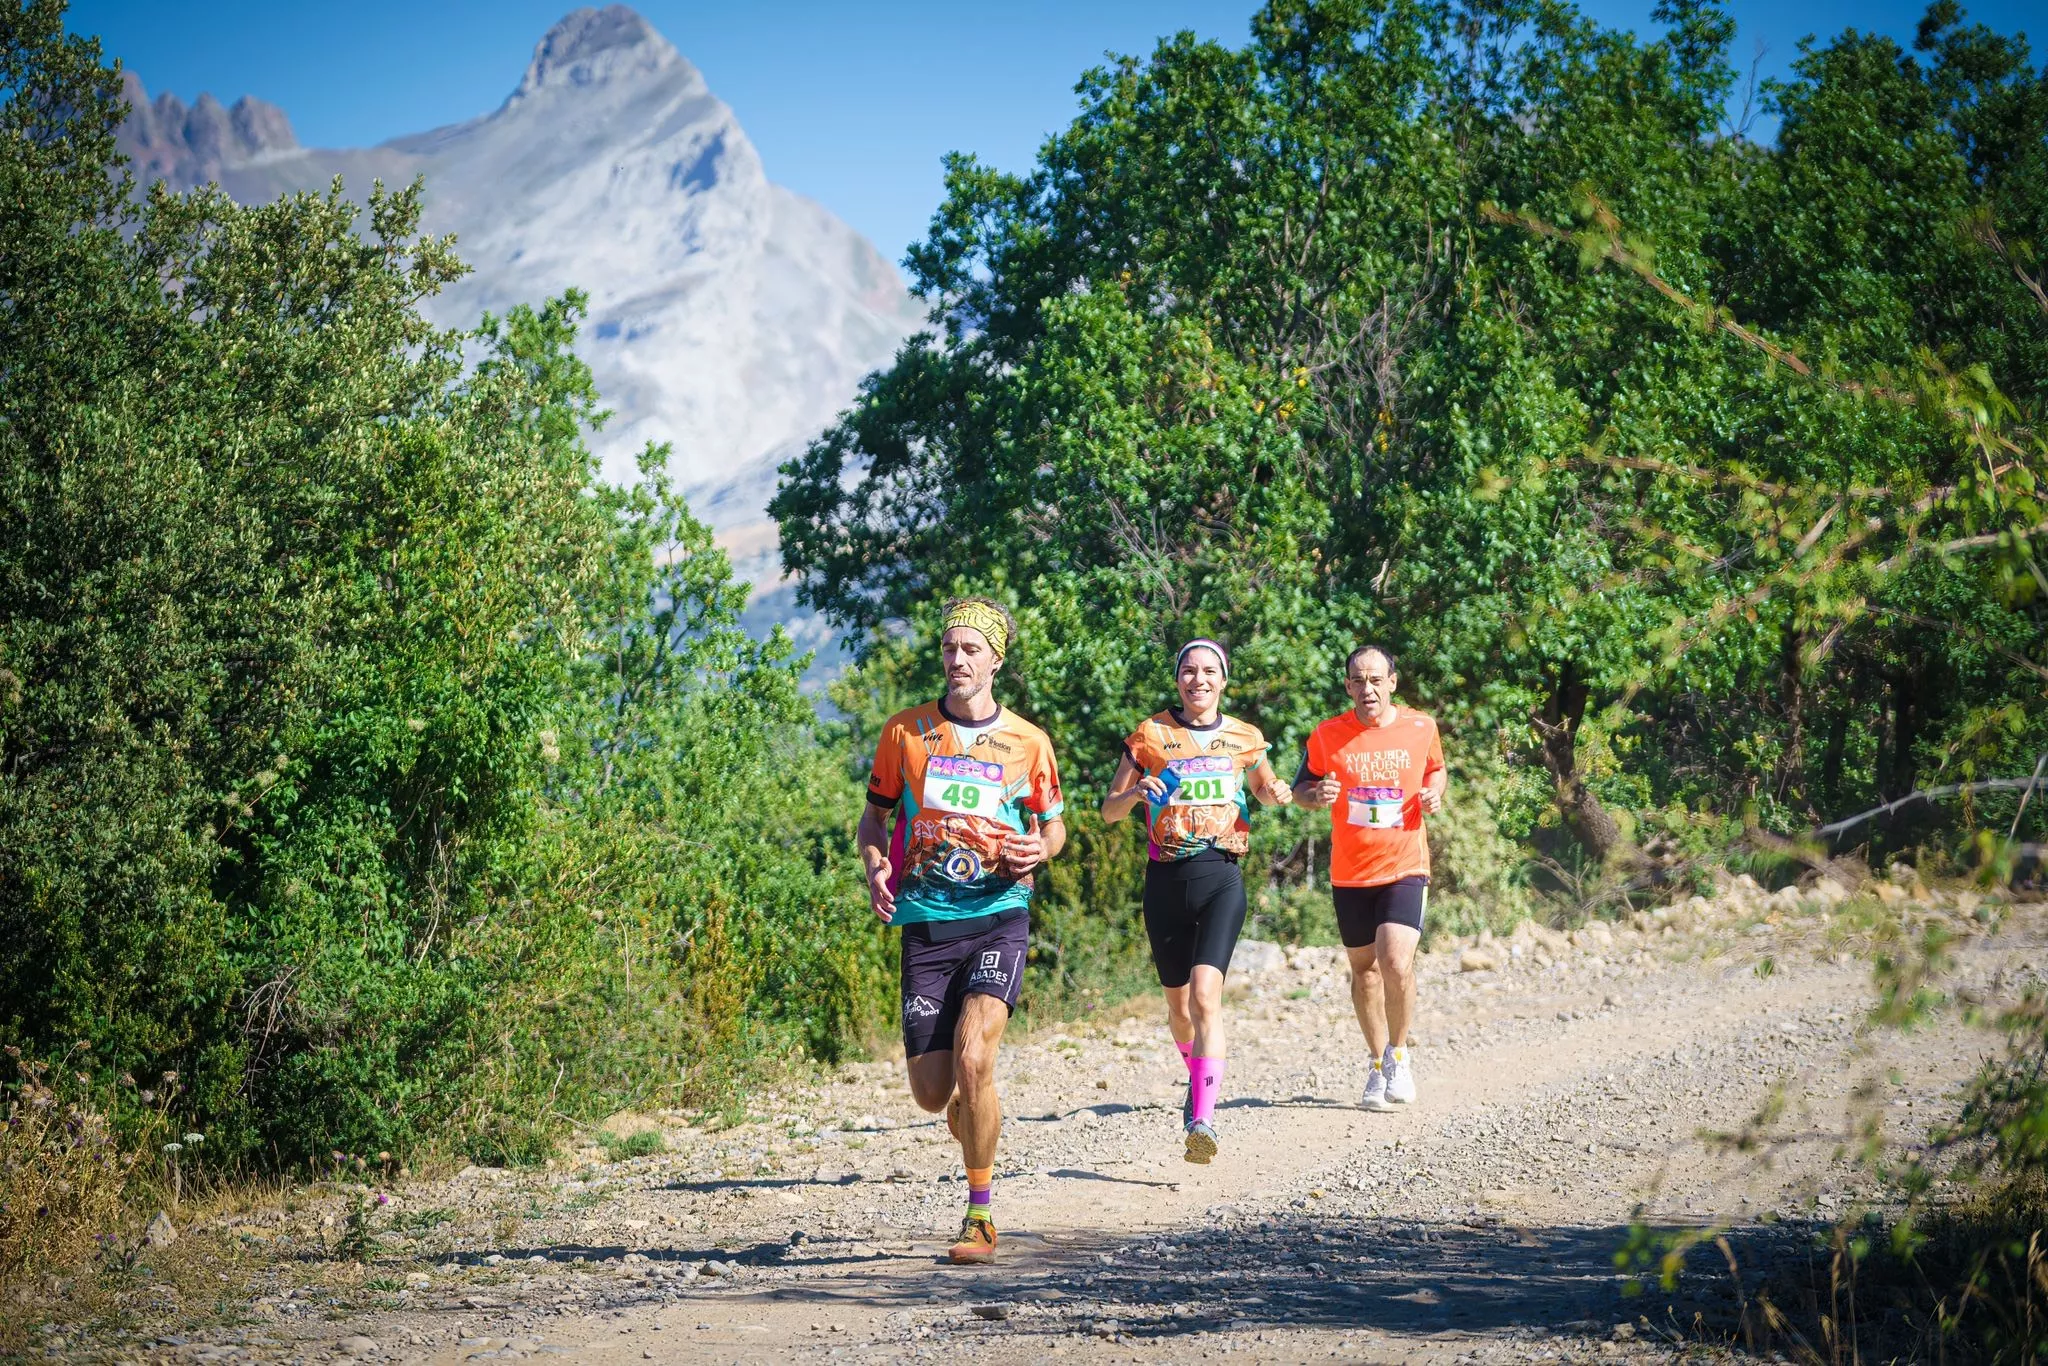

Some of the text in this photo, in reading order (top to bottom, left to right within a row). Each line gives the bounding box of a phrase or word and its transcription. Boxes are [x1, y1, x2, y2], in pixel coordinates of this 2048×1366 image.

[923, 732, 943, 742] vive
[1164, 742, 1181, 750] vive
[1345, 749, 1410, 763] XVIII SUBIDA
[1346, 759, 1411, 773] A LA FUENTE
[1361, 772, 1371, 782] EL
[942, 783, 980, 809] 49
[1179, 779, 1225, 801] 201
[1369, 806, 1380, 823] 1
[969, 969, 1008, 983] ABADES
[920, 1008, 940, 1017] Sport
